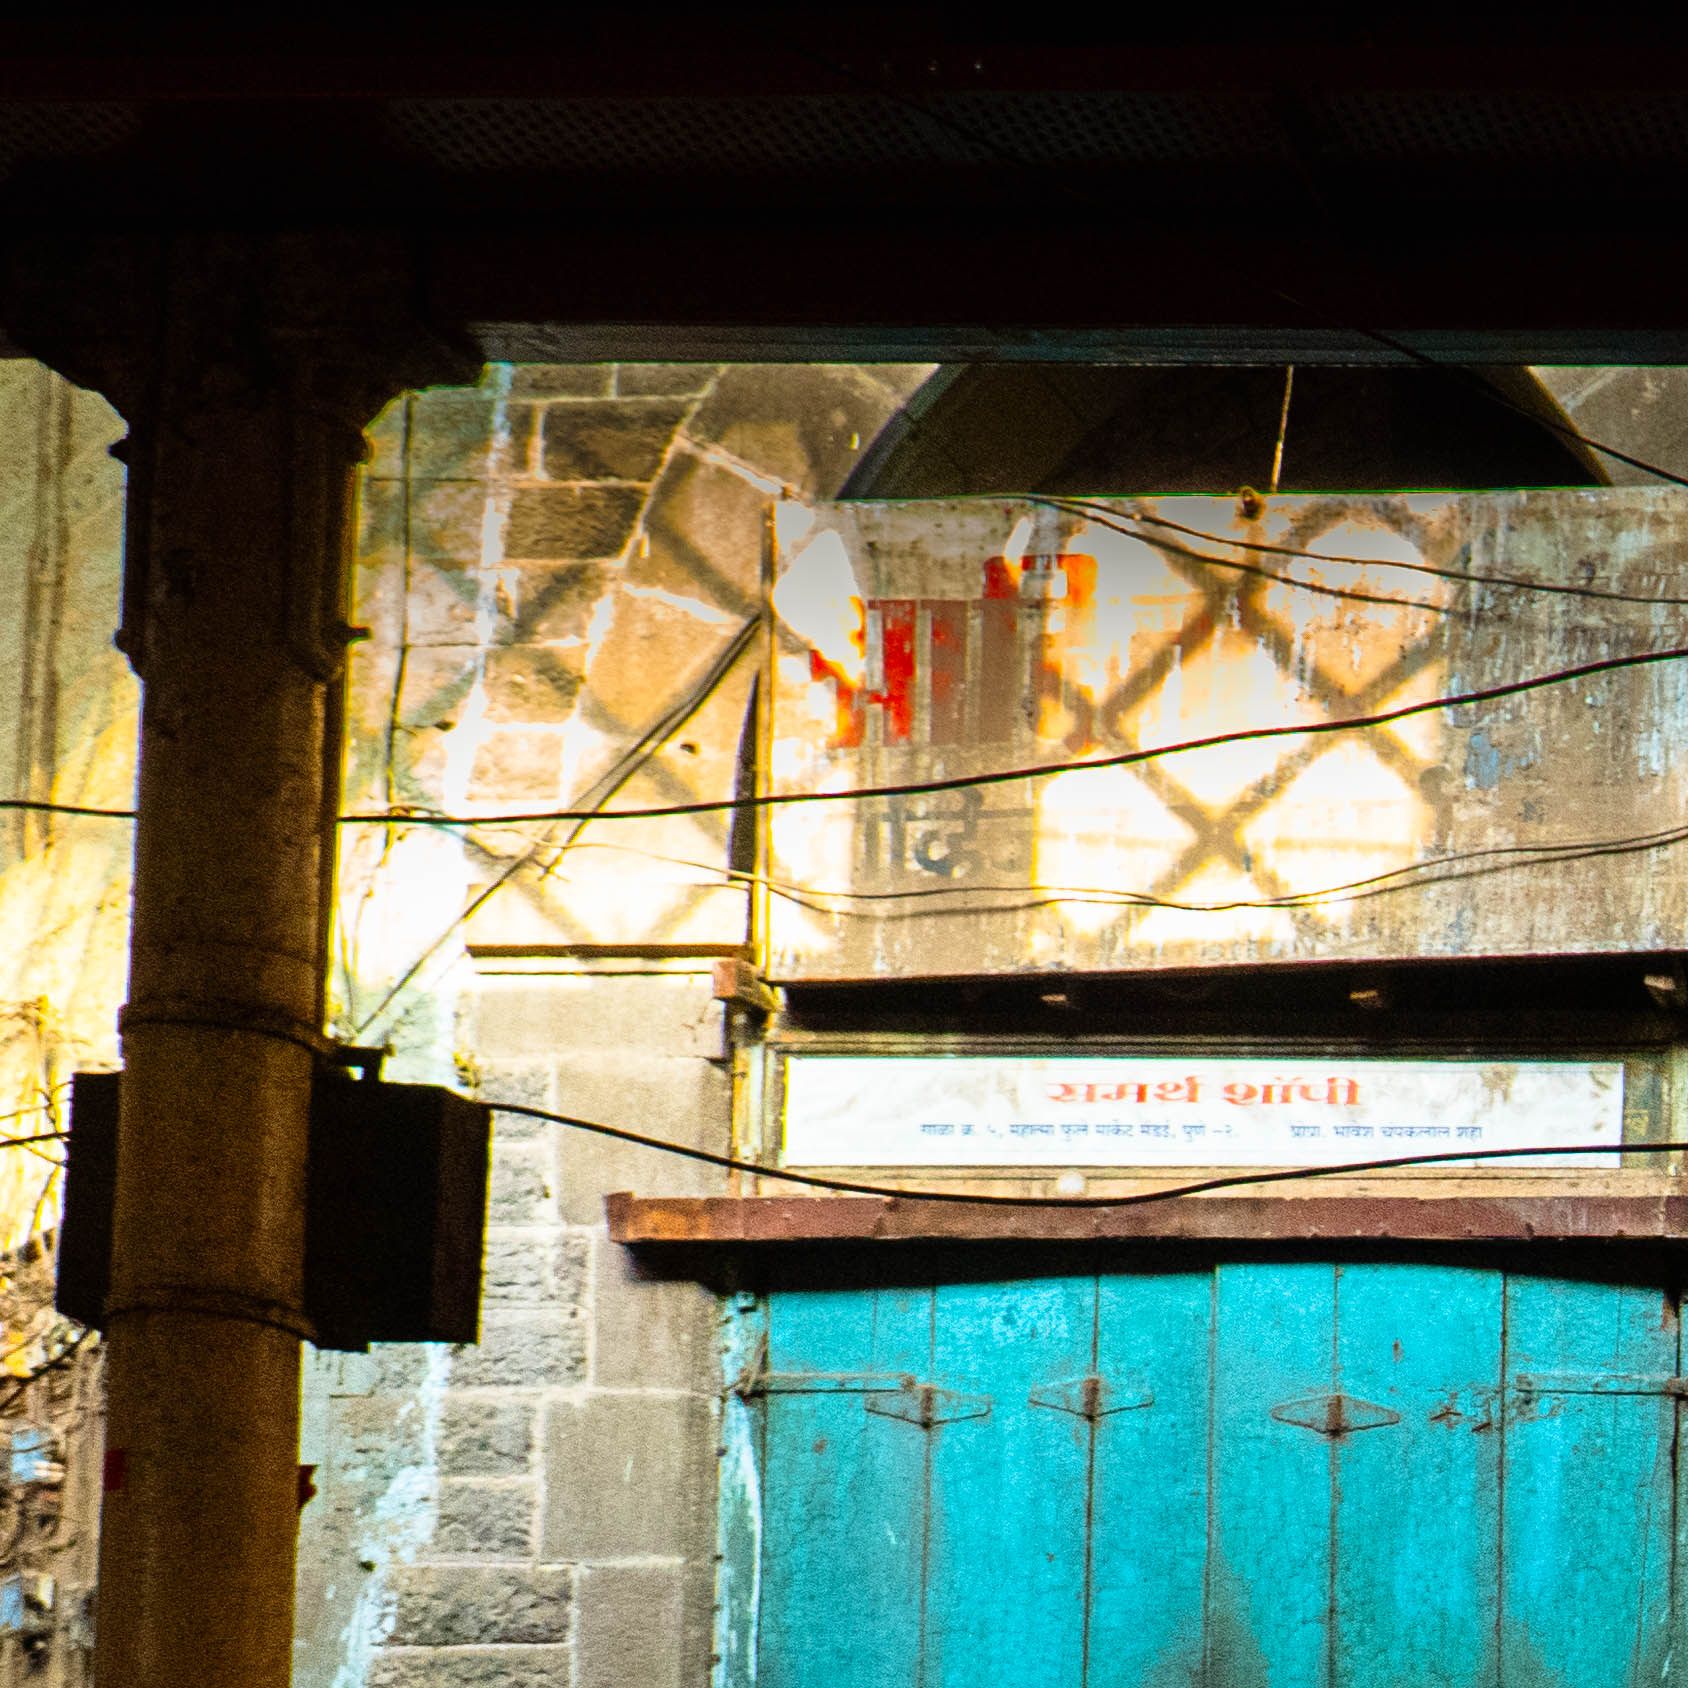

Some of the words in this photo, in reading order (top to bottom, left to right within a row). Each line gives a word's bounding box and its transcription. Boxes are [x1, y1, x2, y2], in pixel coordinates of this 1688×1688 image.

[1047, 1075, 1203, 1104] समर्थ
[1222, 1076, 1360, 1106] शॉपी
[1008, 1122, 1055, 1139] महात्मा
